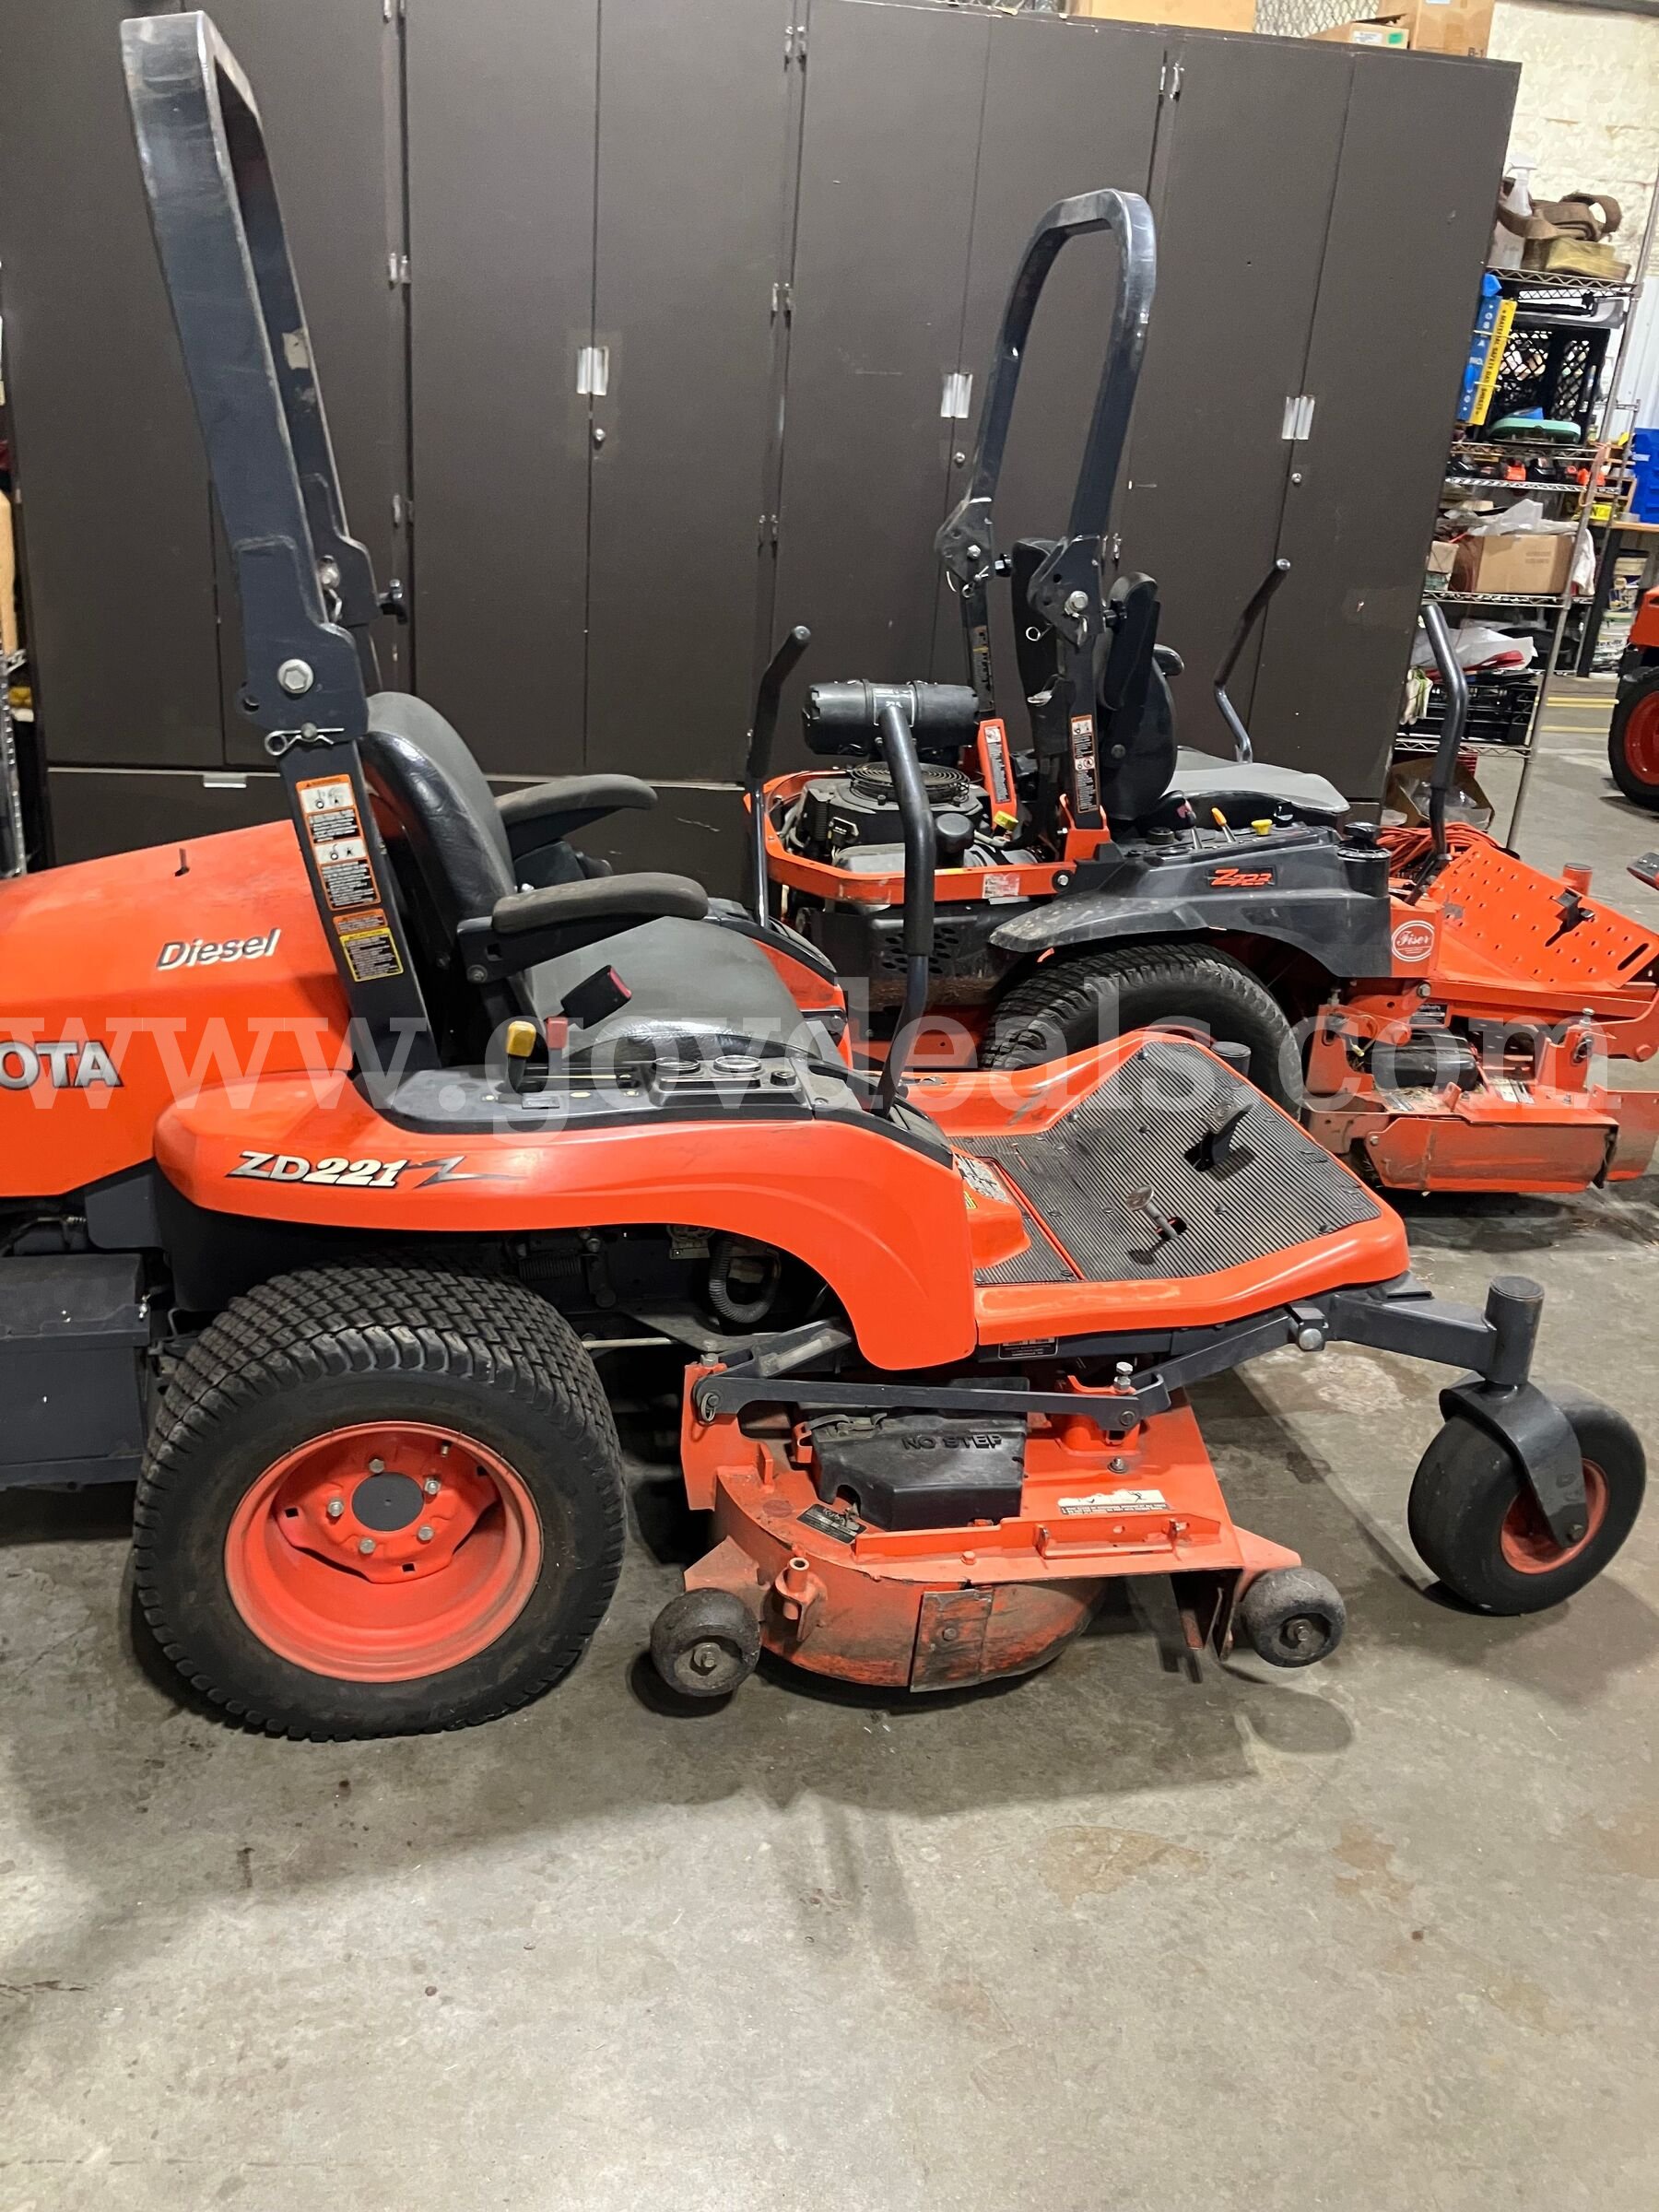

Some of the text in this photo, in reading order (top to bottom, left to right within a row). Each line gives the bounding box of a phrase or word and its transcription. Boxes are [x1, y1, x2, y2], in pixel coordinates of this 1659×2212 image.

[157, 927, 281, 971] Diesel
[226, 1150, 411, 1189] ZD221
[901, 1433, 1003, 1450] NO STEP
